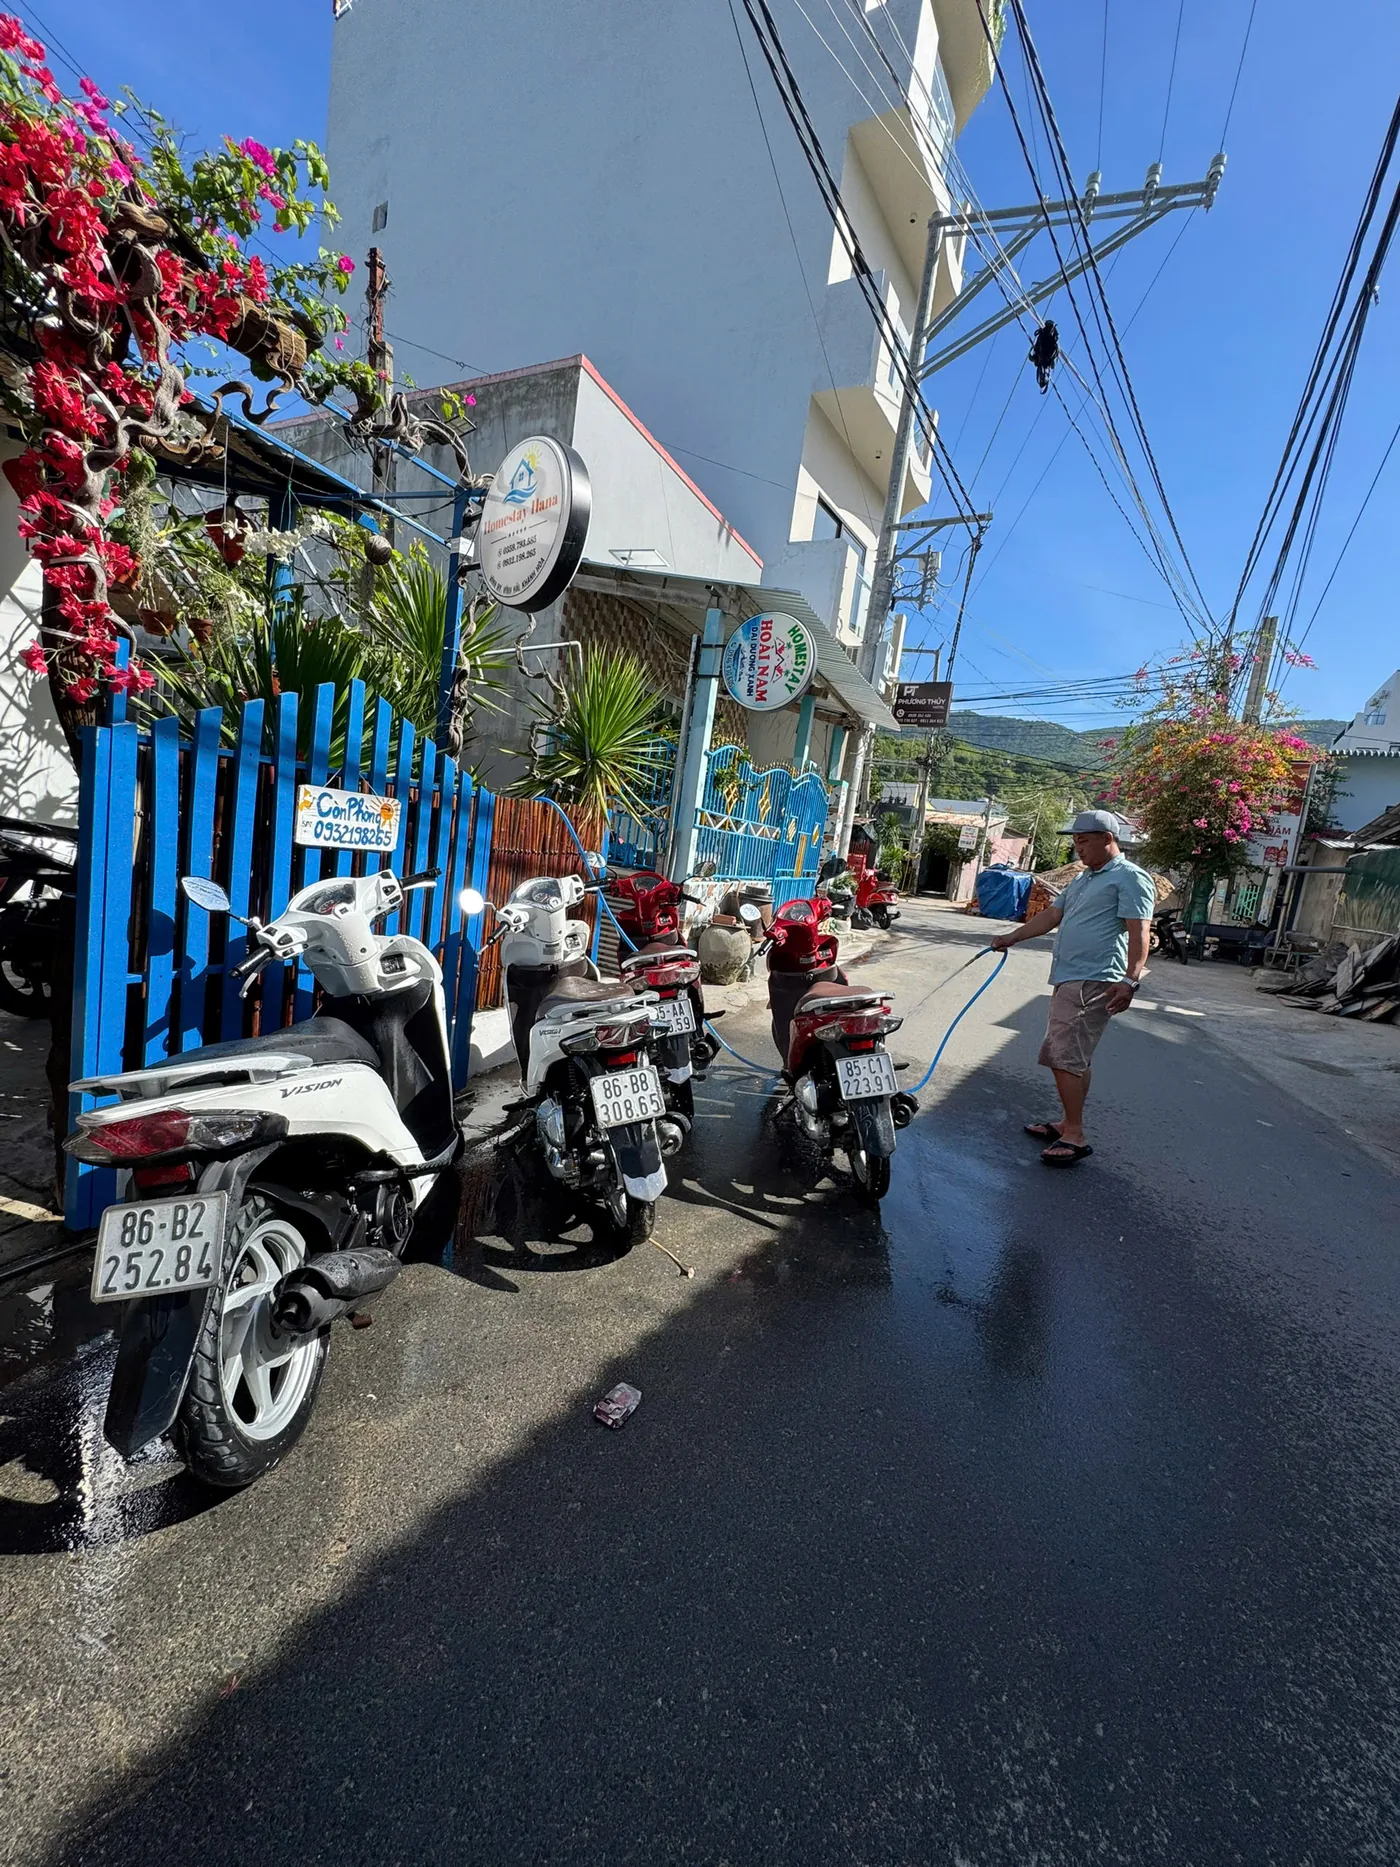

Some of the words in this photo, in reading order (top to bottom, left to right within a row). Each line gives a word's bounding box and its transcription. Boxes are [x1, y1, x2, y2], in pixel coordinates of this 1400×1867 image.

[484, 508, 527, 534] Homestay
[759, 620, 774, 660] HOÀI
[785, 624, 807, 694] HOMESTAY
[755, 666, 769, 701] NAM
[314, 820, 393, 847] 0932198265
[845, 1056, 884, 1077] 85-C1
[280, 1078, 343, 1099] VISION
[602, 1072, 649, 1100] 86-B8
[843, 1074, 893, 1097] 223.91
[600, 1092, 661, 1123] 308.65
[120, 1201, 206, 1248] 86-B2
[101, 1241, 213, 1295] 252.84
